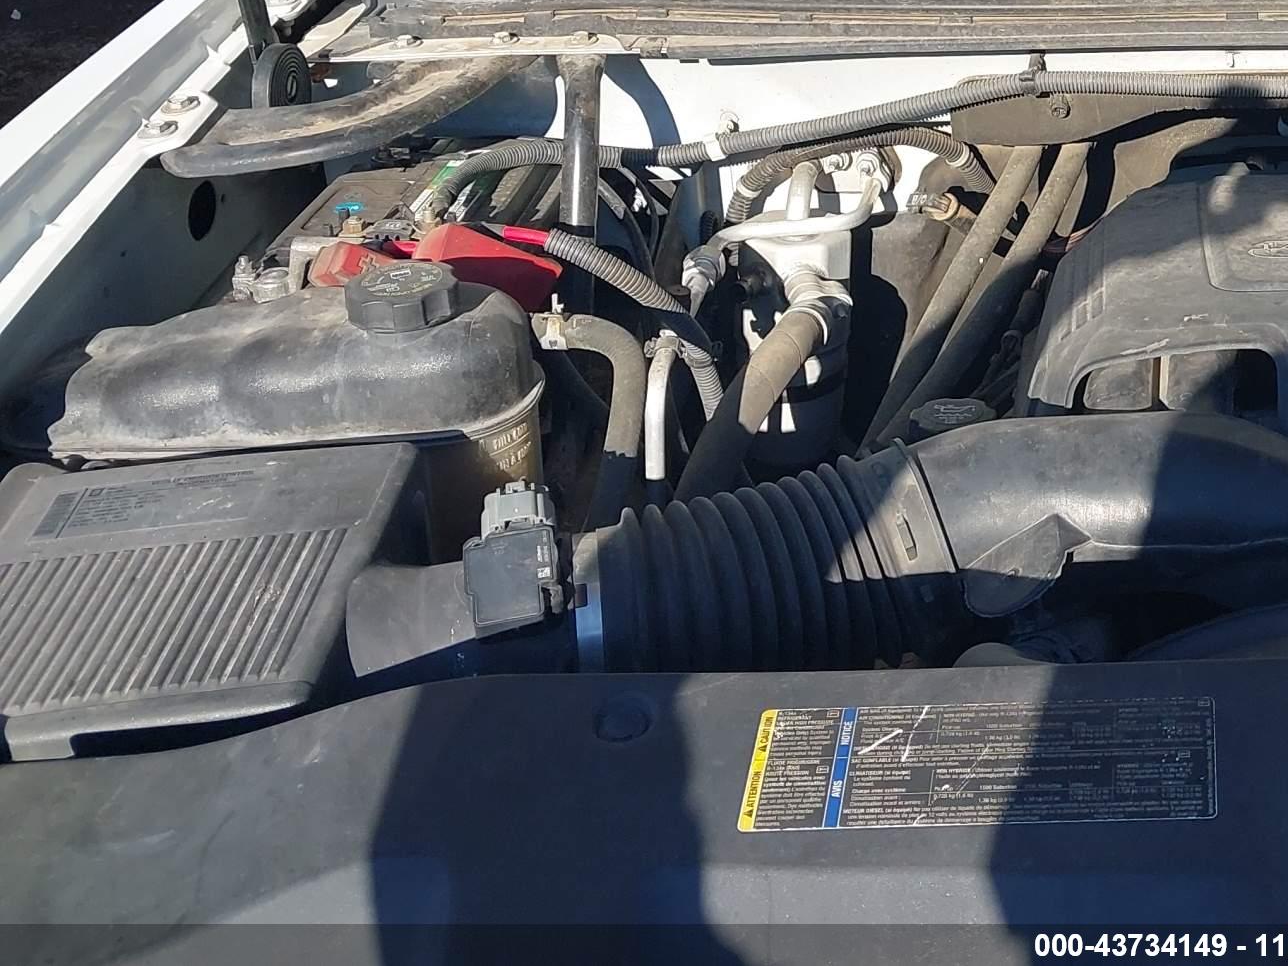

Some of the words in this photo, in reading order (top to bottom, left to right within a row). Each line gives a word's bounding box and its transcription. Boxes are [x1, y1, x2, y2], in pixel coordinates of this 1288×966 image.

[760, 716, 774, 743] CAUTION
[840, 721, 853, 745] NOTICE
[746, 770, 762, 807] ATTENTION
[831, 780, 843, 798] AVIS
